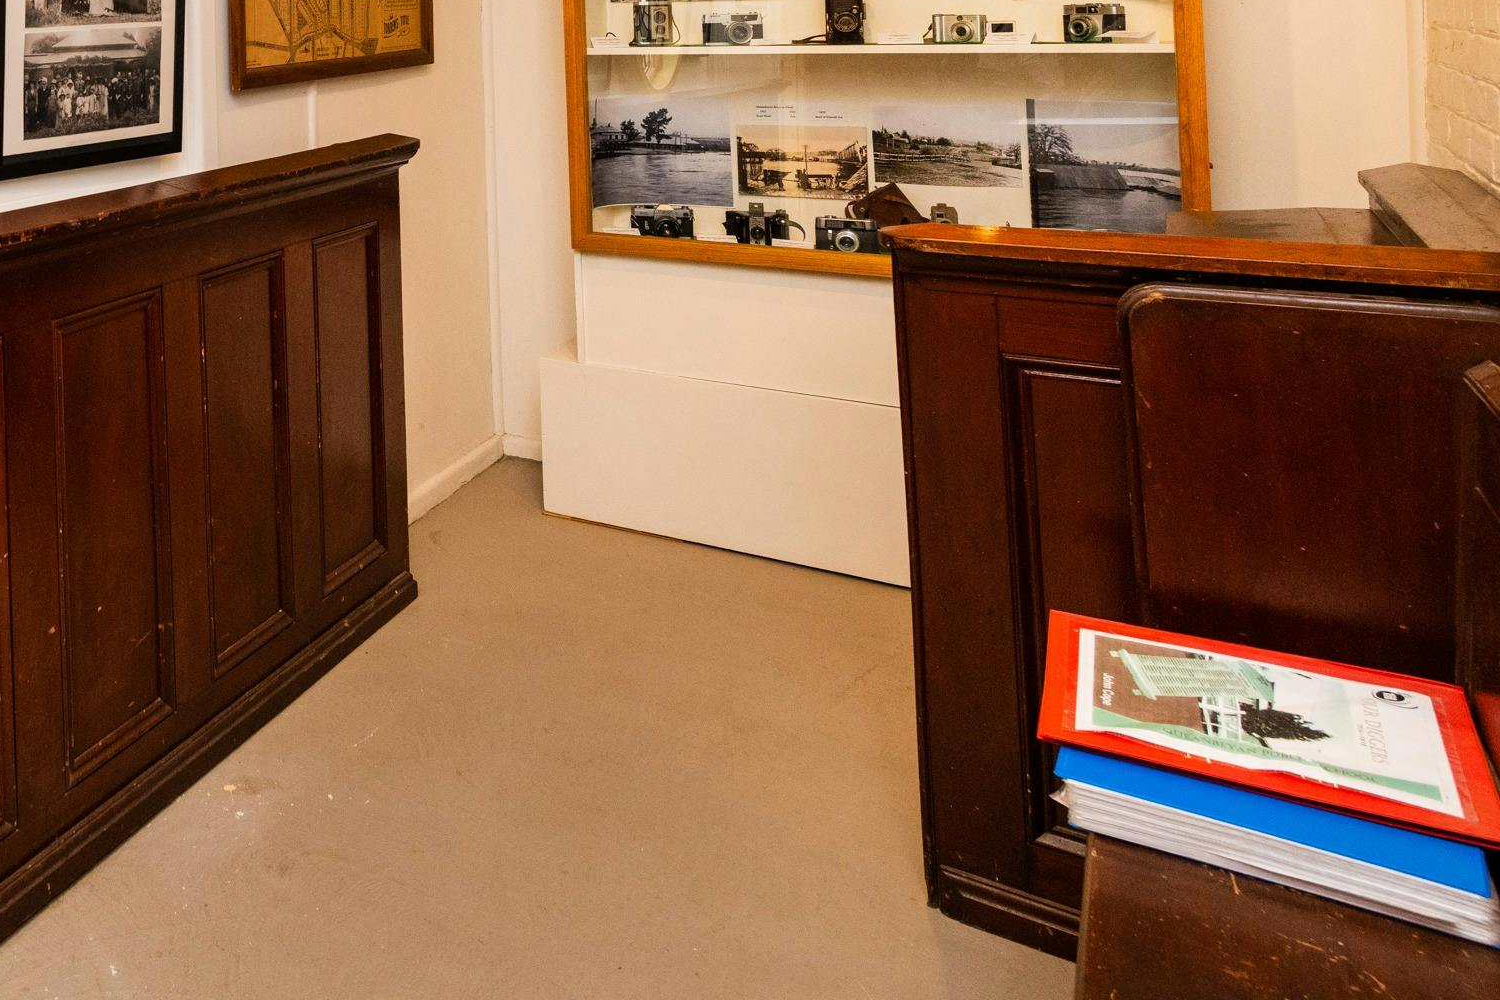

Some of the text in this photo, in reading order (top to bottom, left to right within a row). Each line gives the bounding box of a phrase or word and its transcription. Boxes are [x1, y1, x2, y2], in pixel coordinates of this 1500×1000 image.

[1100, 672, 1115, 706] John Cope
[1364, 719, 1390, 765] DIGGERS
